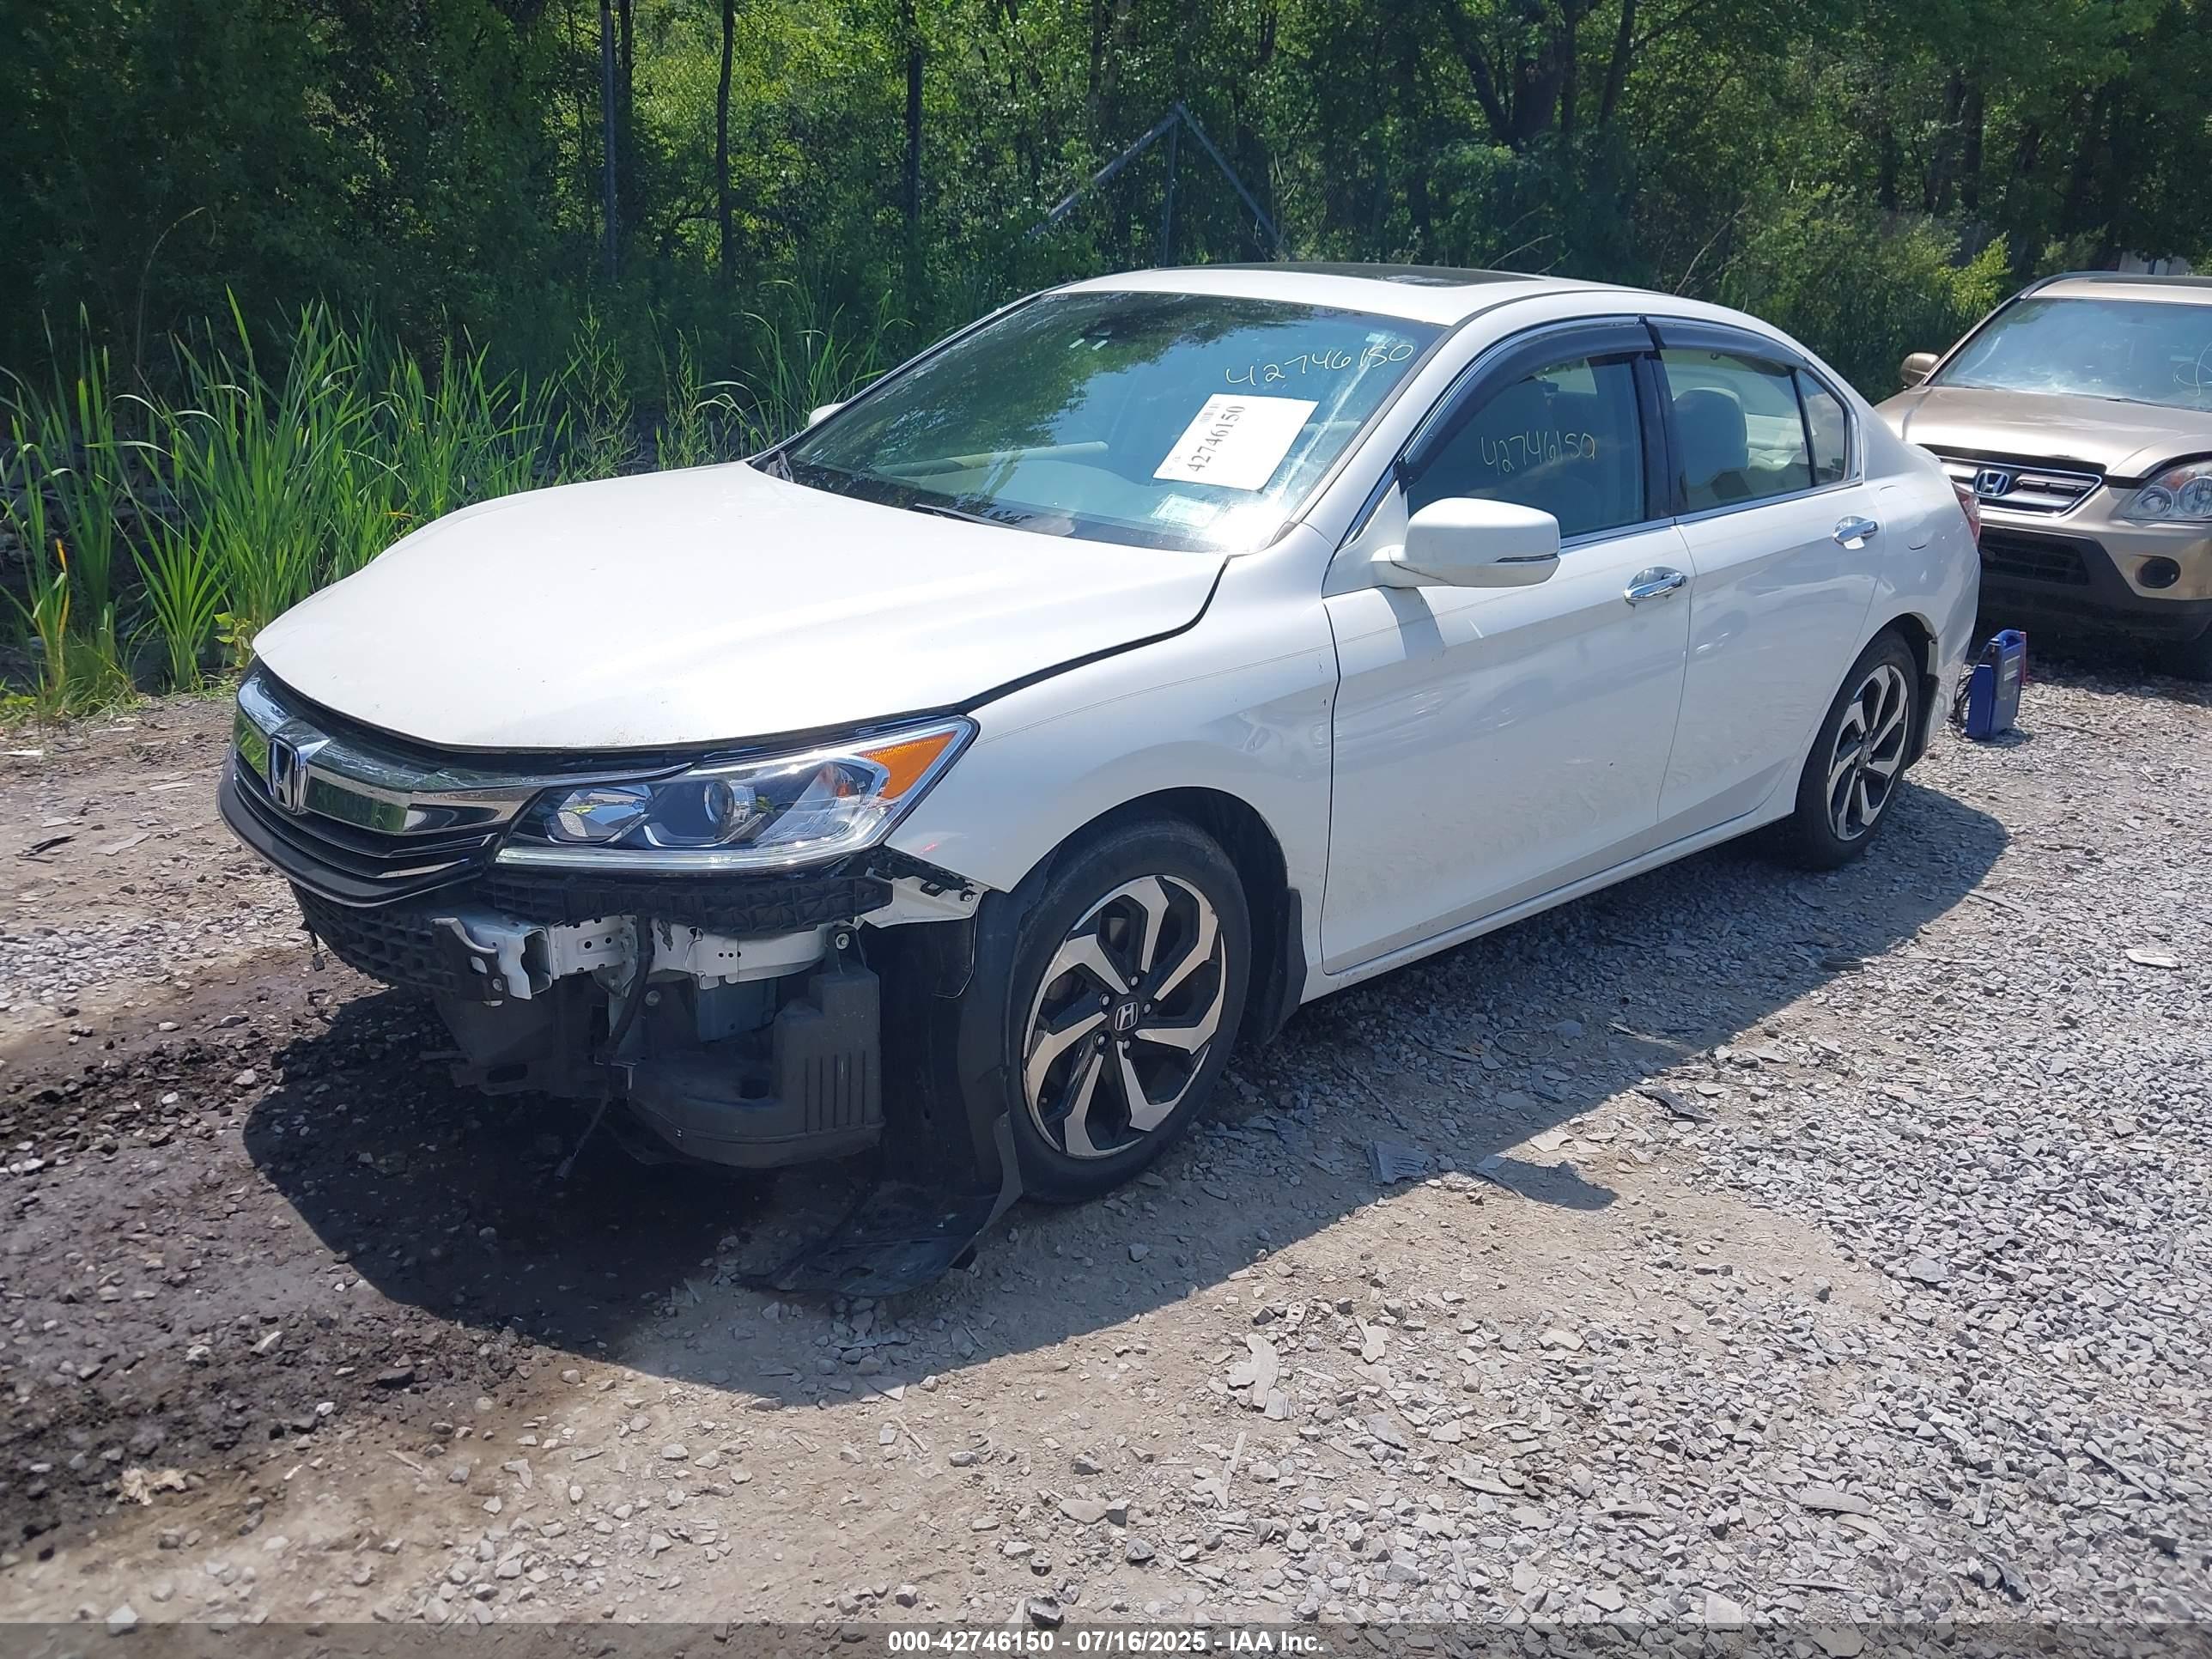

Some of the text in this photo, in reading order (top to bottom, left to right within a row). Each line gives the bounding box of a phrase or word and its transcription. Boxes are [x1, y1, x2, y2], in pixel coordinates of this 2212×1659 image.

[1225, 344, 1415, 386] 42746150
[1187, 405, 1246, 472] 42746150
[1480, 430, 1595, 476] 42746150
